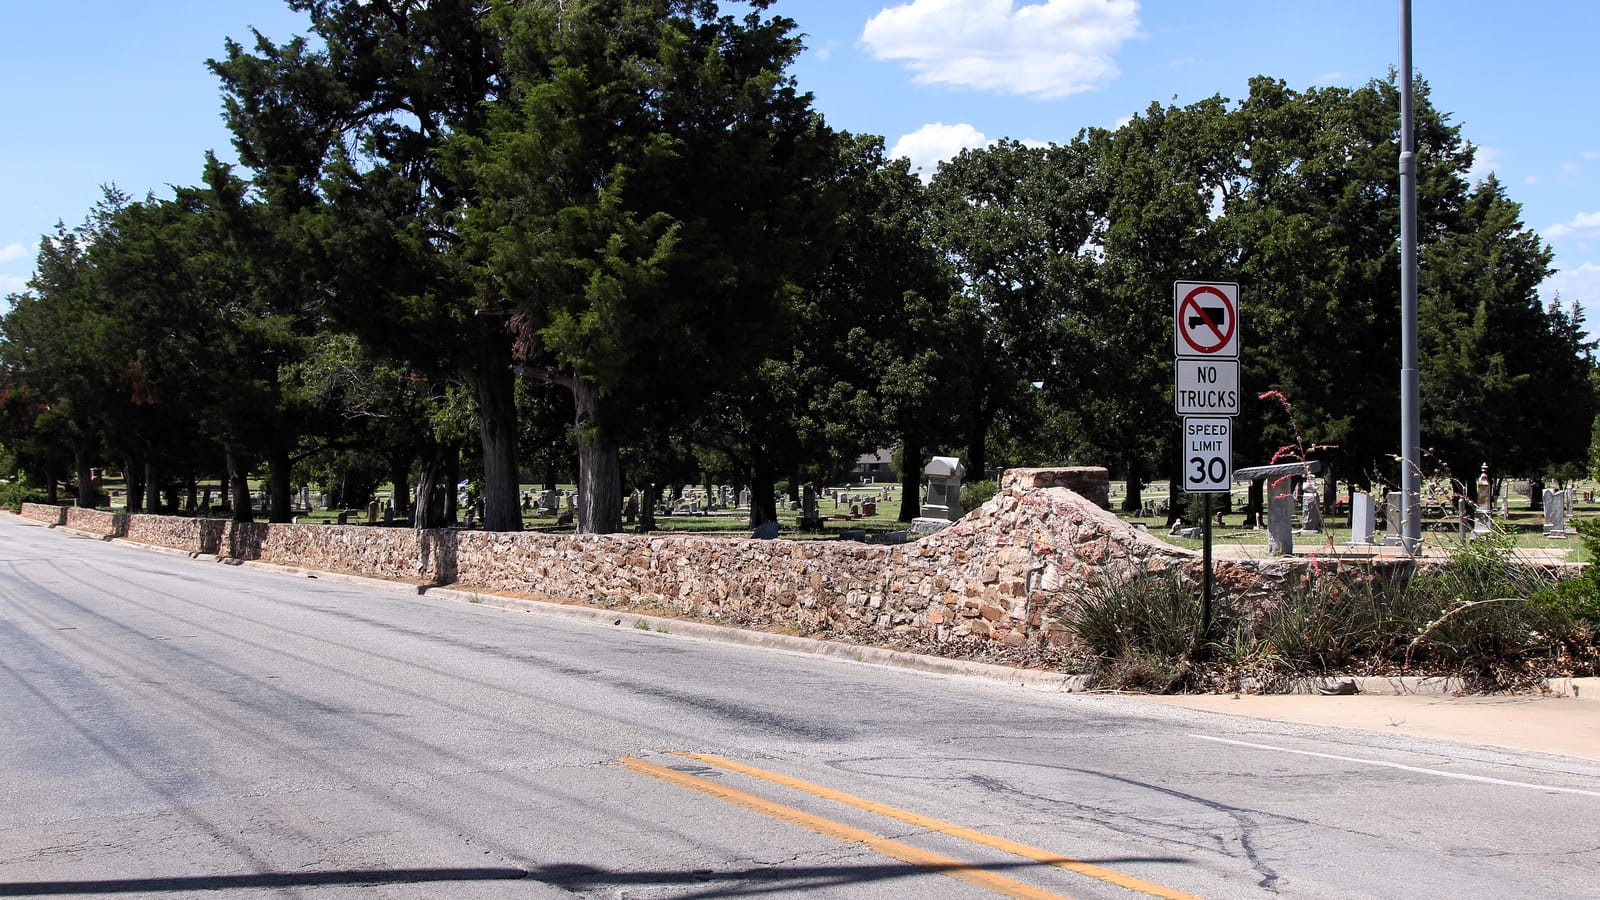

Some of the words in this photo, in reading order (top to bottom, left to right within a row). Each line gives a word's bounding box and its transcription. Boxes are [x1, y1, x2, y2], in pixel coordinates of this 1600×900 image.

[1197, 366, 1217, 384] NO
[1179, 390, 1236, 408] TRUCKS
[1188, 424, 1228, 436] SPEED
[1192, 441, 1223, 452] LIMIT
[1189, 456, 1227, 484] 30
